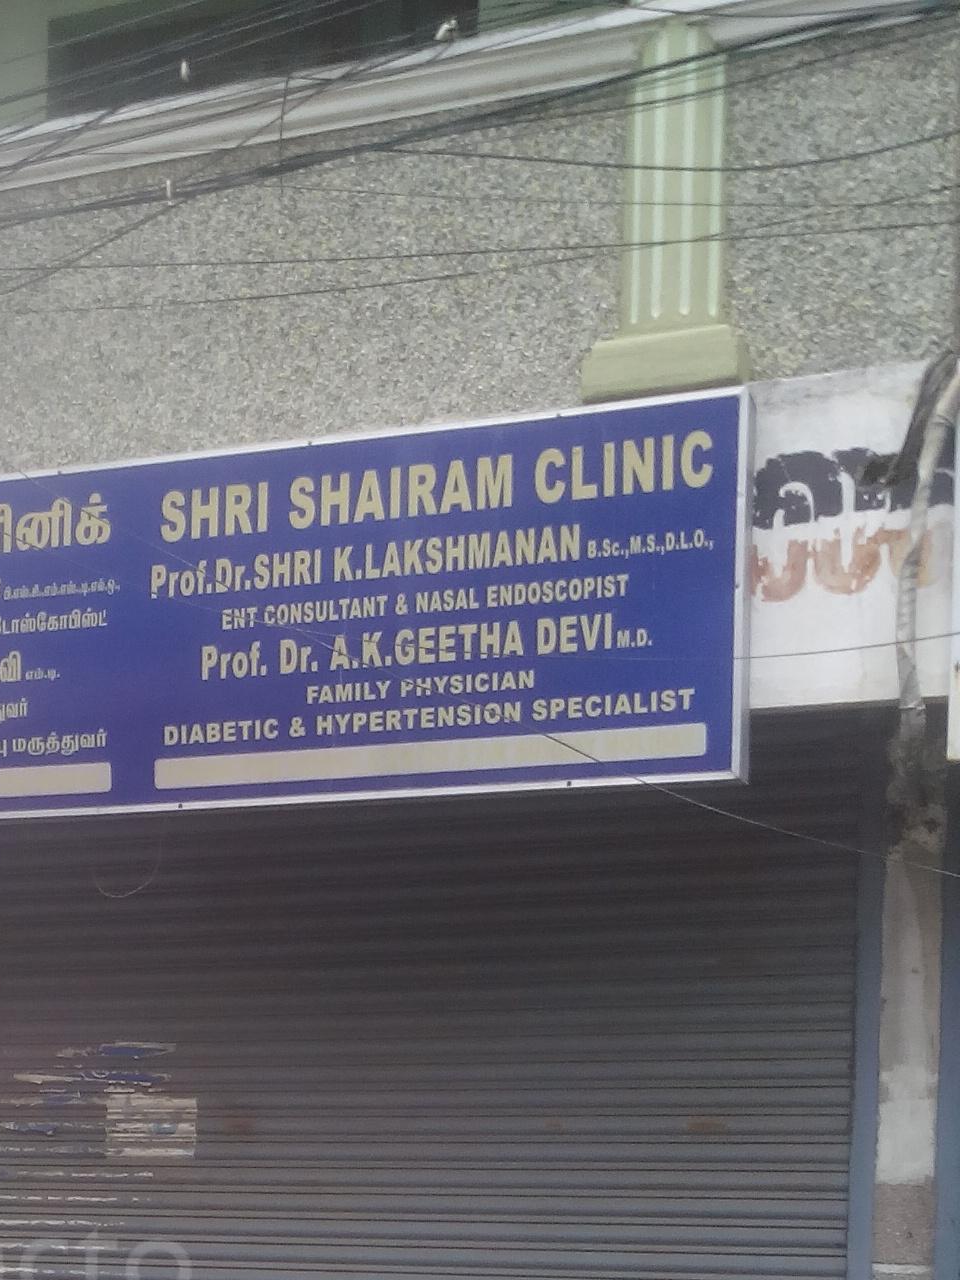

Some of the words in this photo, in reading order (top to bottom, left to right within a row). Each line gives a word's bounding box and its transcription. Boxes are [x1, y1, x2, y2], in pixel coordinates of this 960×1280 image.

[160, 480, 268, 543] SHRI
[289, 455, 513, 530] SHAIRAM
[535, 430, 714, 505] CLINIC
[334, 524, 581, 582] K.LAKSHMANAN
[222, 606, 258, 630] ENT
[264, 595, 388, 625] CONSULTANT
[395, 597, 409, 615] &
[416, 587, 480, 614] NASAL
[487, 574, 630, 608] ENDOSCOPIST
[201, 641, 268, 681] Prof.
[279, 639, 319, 675] Dr.
[330, 620, 524, 671] A.K.GEETHA
[537, 612, 613, 656] DEVI
[616, 628, 653, 649] M.D.
[306, 680, 391, 704] FAMILY
[400, 670, 535, 698] PHYSICIAN
[12, 728, 108, 755] மருத்துவர்
[164, 718, 279, 746] DIABETIC
[289, 716, 306, 737] &
[316, 701, 522, 736] HYPERTENSION
[532, 688, 696, 722] SPECIALIST
